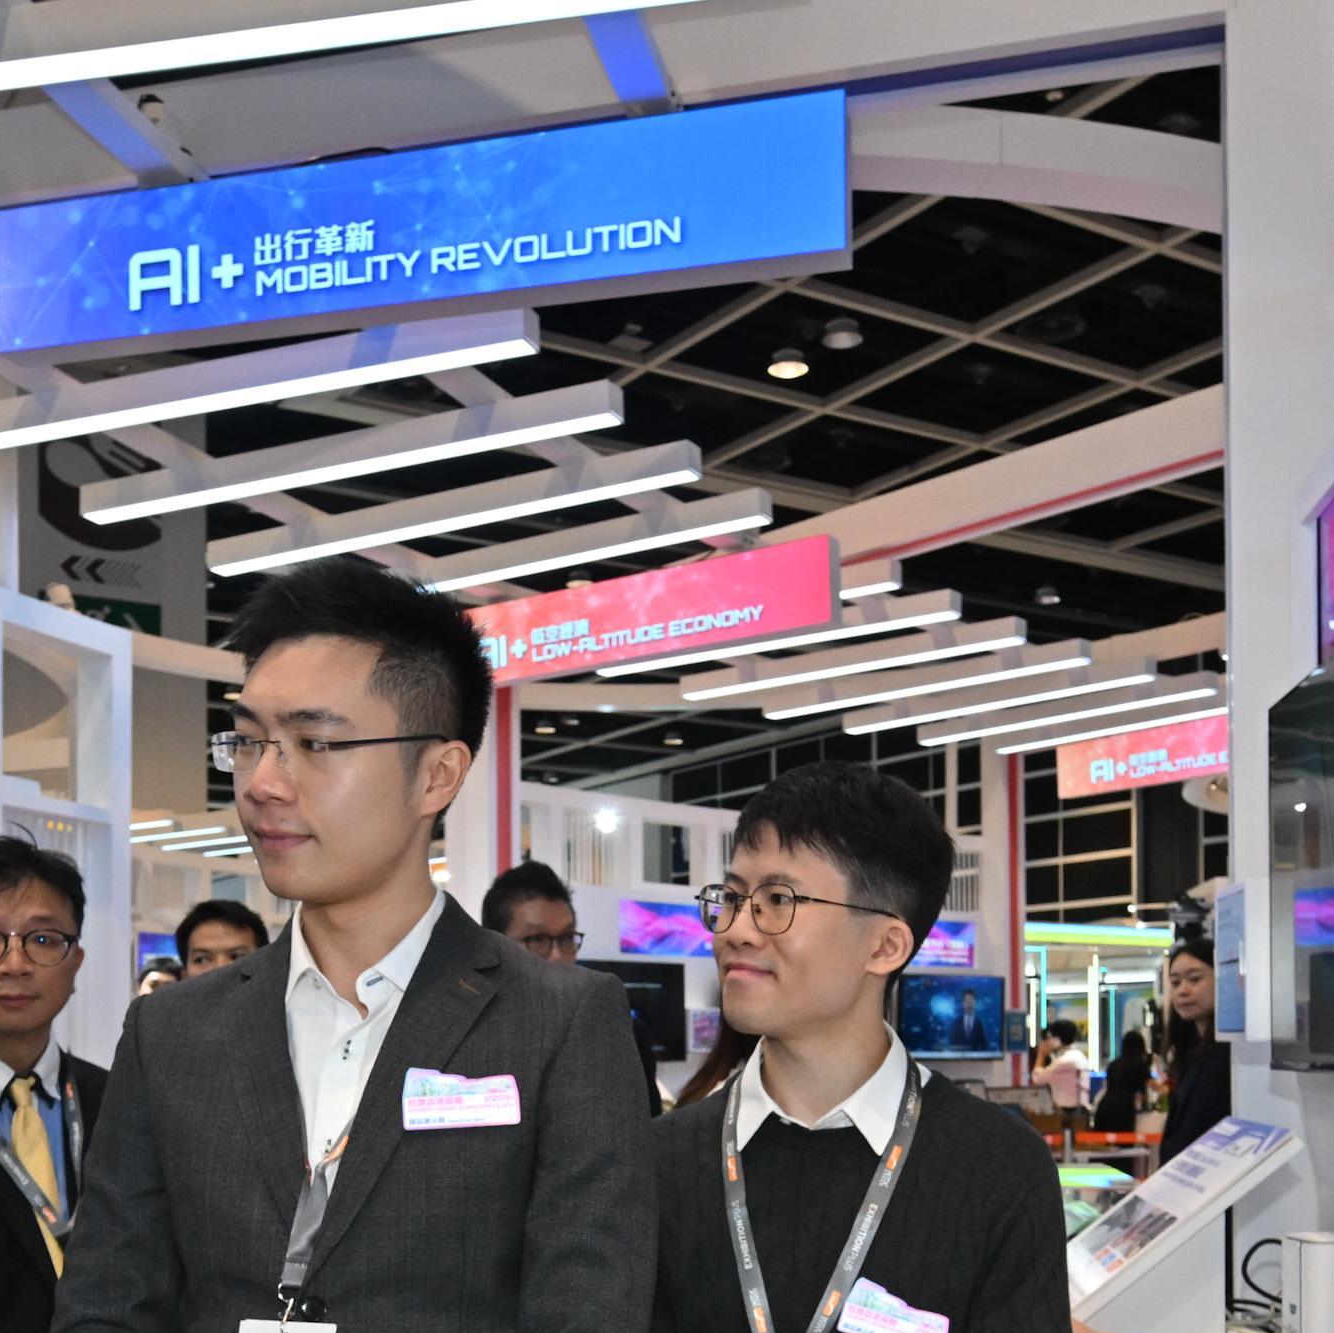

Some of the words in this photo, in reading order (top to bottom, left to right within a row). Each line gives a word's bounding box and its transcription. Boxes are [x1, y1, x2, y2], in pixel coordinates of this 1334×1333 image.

[254, 219, 375, 266] 出行革新
[254, 250, 423, 297] MOBILITY
[430, 216, 682, 276] REVOLUTION
[531, 622, 665, 662] LOW-ALTITUDE
[669, 604, 763, 638] ECONOMY
